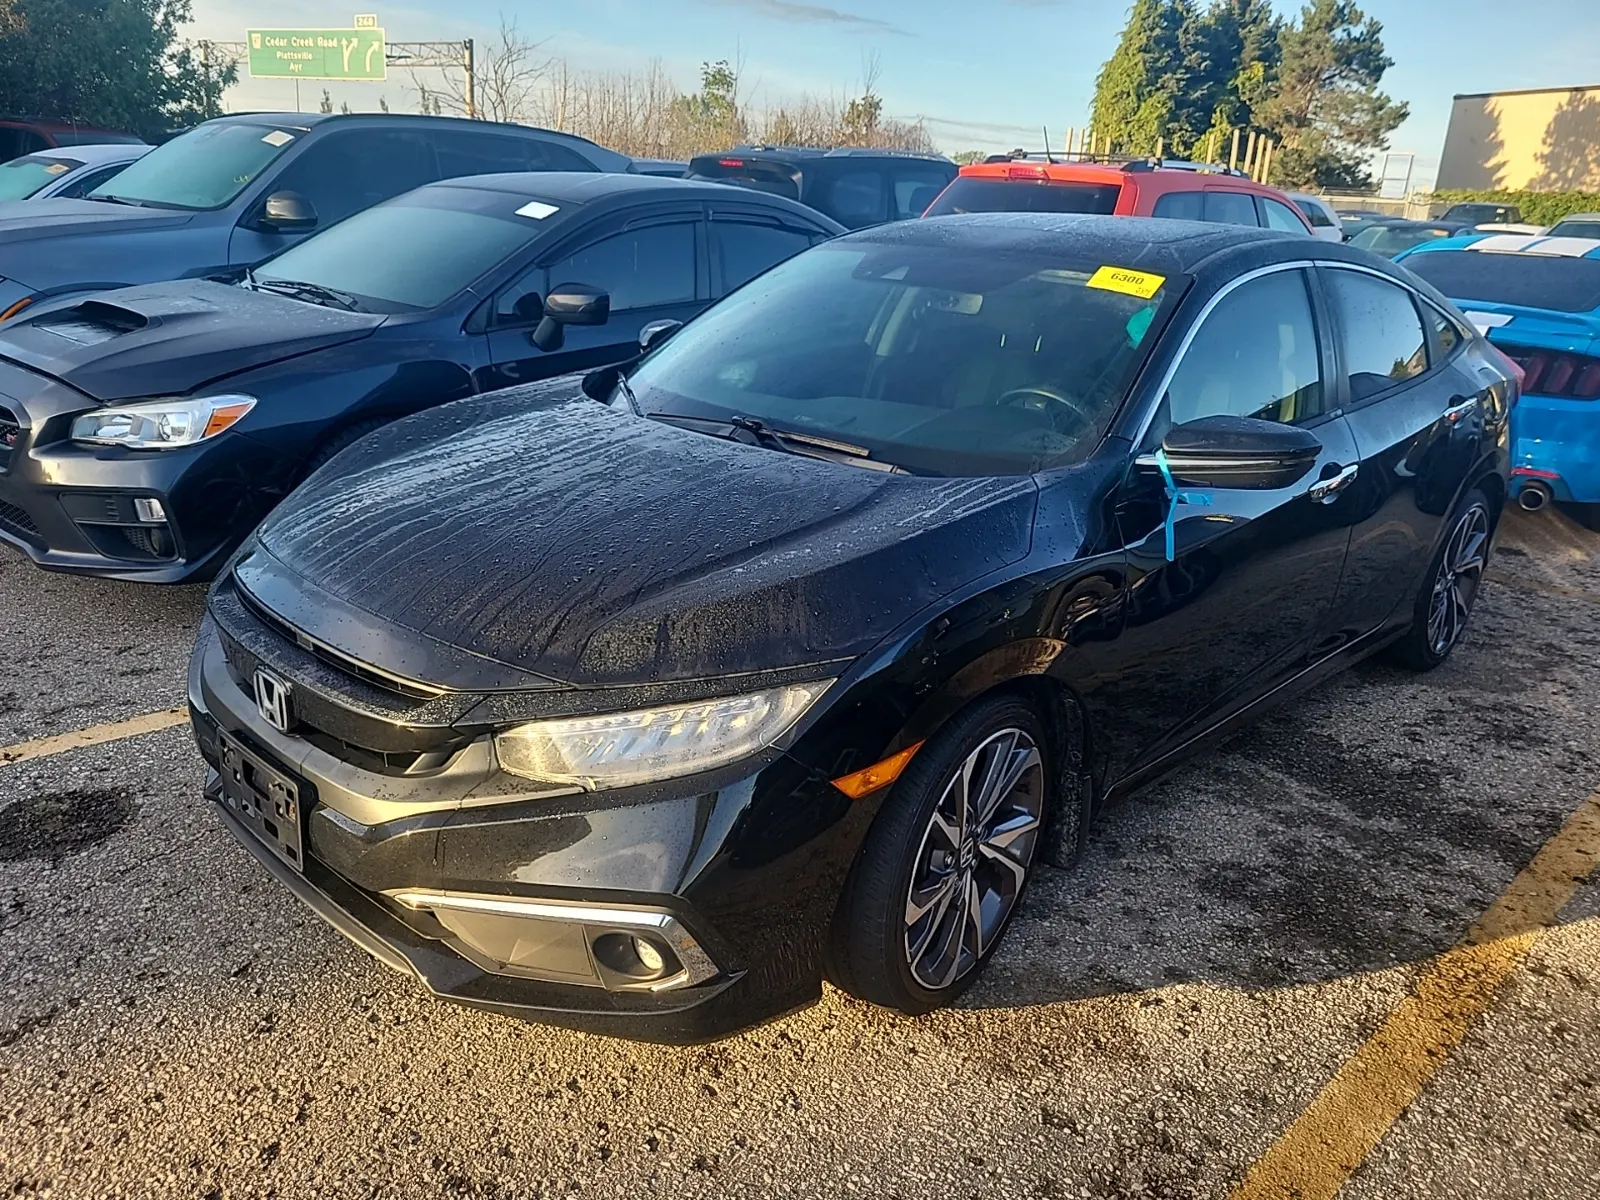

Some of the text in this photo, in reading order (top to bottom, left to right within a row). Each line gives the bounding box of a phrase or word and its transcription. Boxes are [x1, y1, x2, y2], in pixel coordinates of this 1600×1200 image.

[357, 17, 374, 27] 268
[265, 36, 288, 47] Cedar
[291, 36, 314, 47] Creek
[317, 36, 338, 48] Road
[276, 50, 313, 60] Plattsville
[289, 62, 303, 72] Ayr
